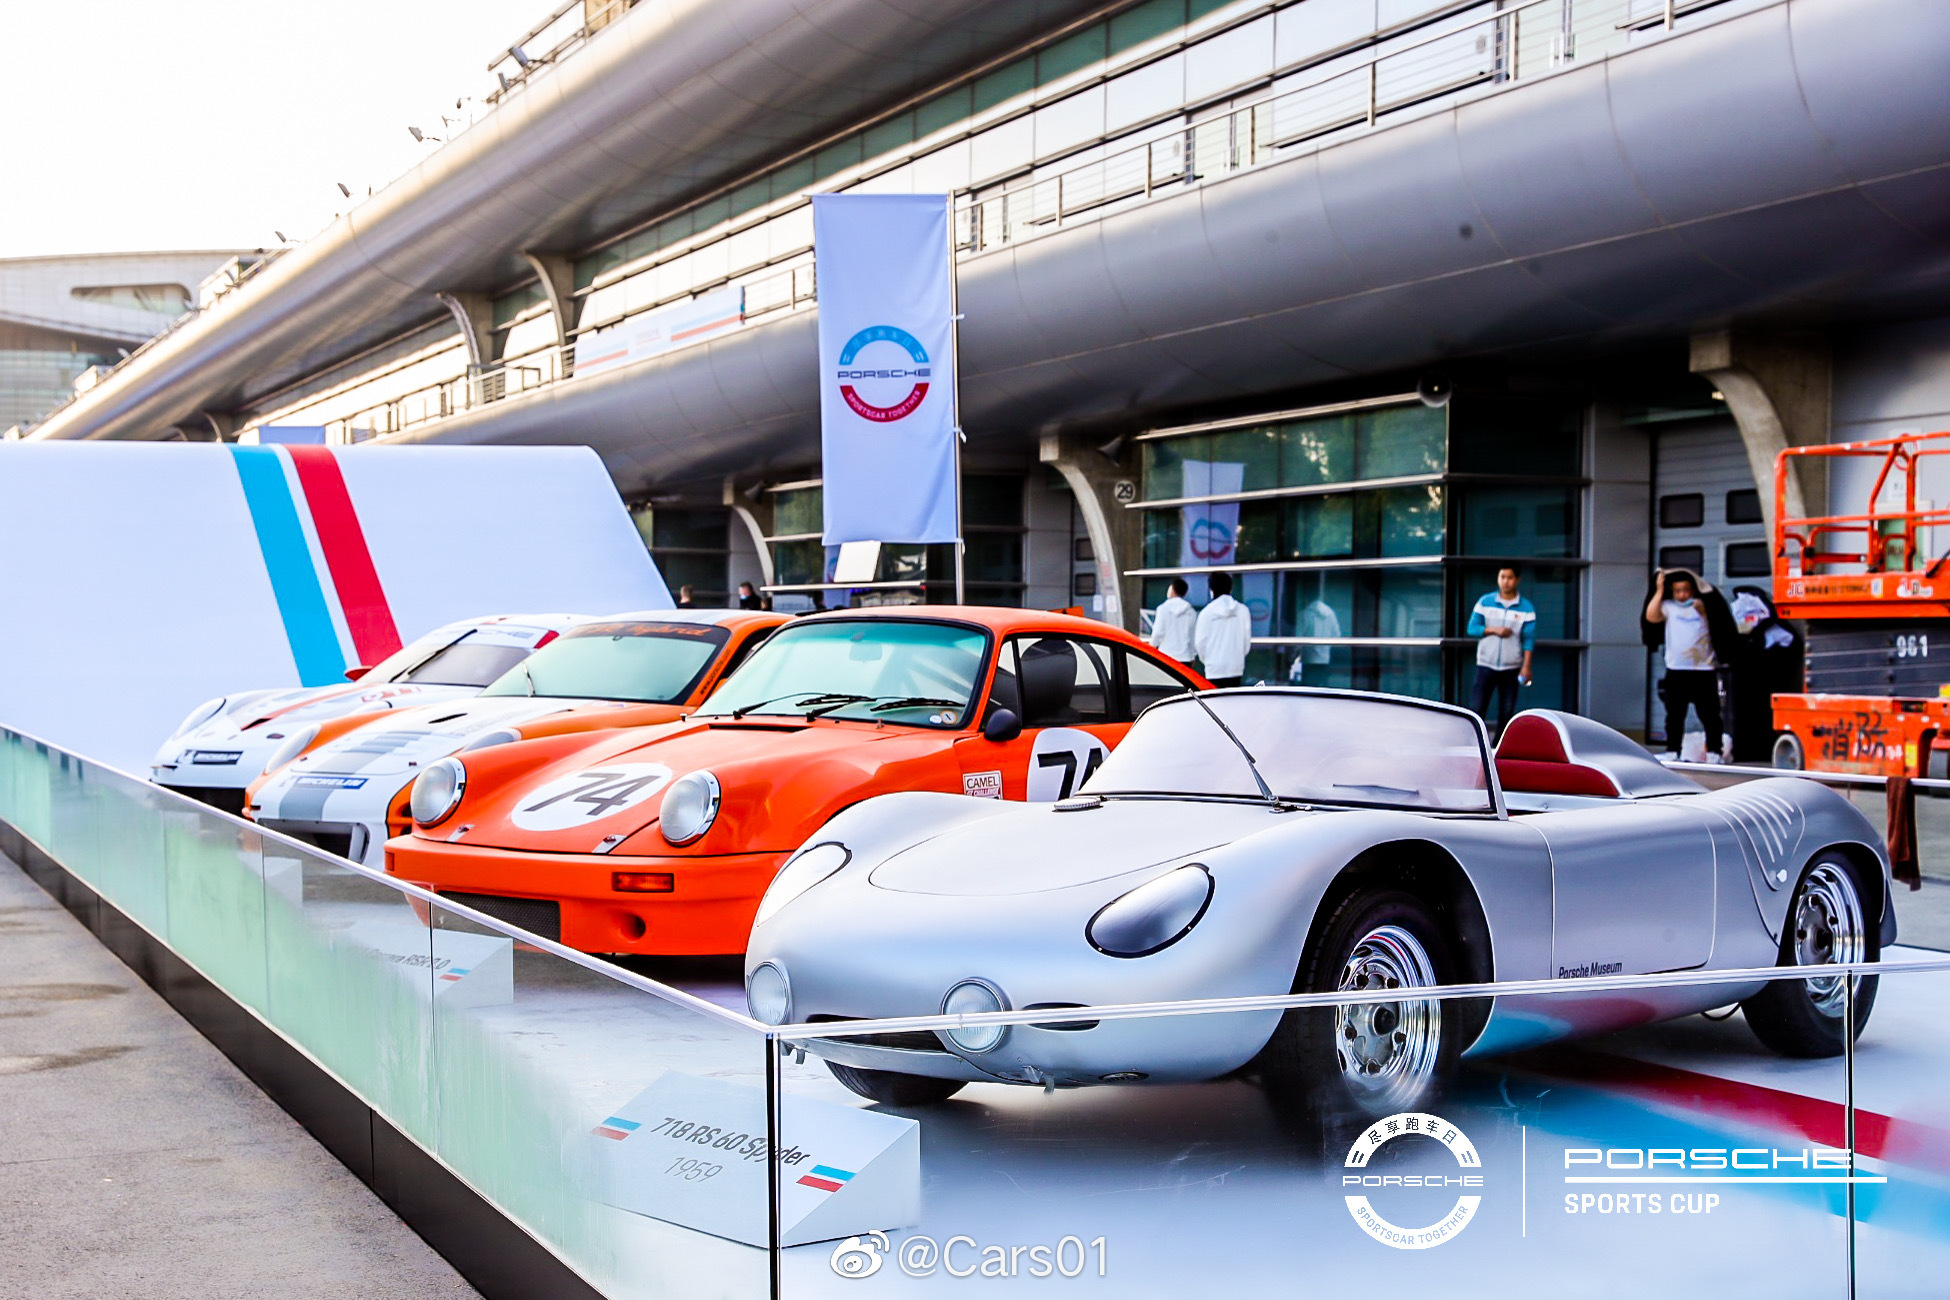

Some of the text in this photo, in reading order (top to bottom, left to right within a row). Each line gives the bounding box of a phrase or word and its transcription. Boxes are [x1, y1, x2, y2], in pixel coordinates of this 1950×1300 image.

[837, 367, 931, 379] PORSCHE
[1116, 483, 1134, 499] 29
[1896, 634, 1928, 658] 961
[966, 776, 998, 789] CAMEL
[522, 772, 662, 817] 74
[1559, 961, 1623, 979] Porsche Museum
[650, 1116, 695, 1139] 718
[685, 1125, 721, 1144] RS
[711, 1131, 749, 1151] 60
[663, 1156, 723, 1183] 1959
